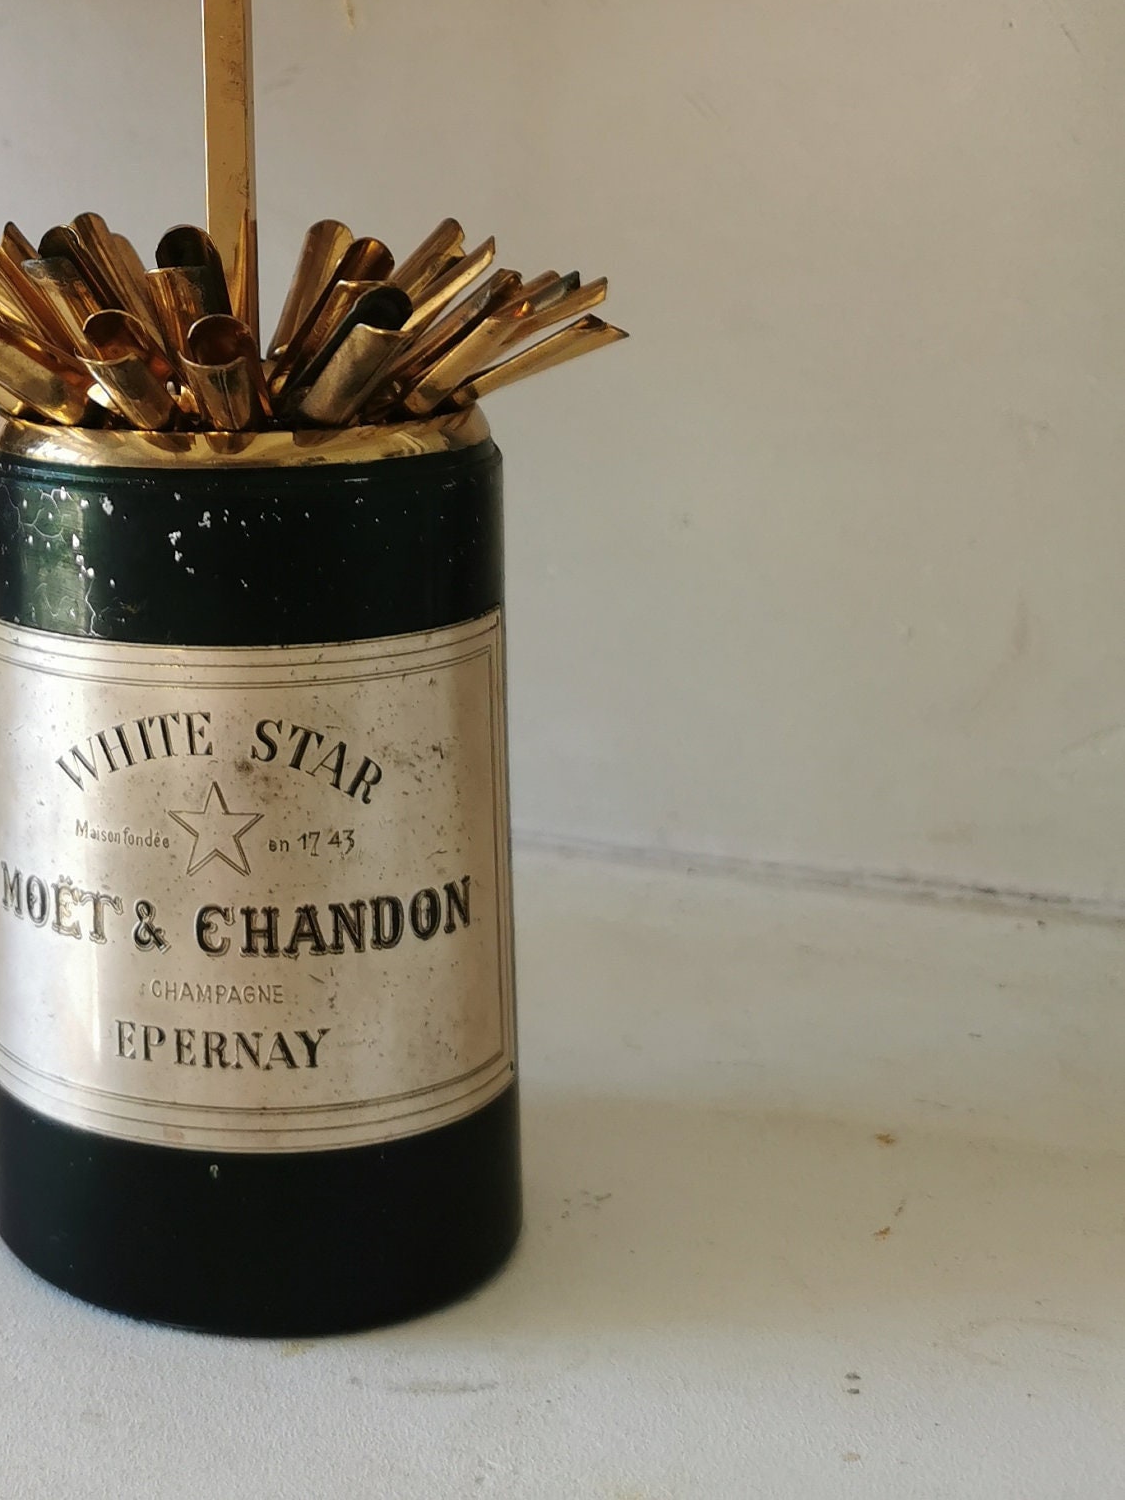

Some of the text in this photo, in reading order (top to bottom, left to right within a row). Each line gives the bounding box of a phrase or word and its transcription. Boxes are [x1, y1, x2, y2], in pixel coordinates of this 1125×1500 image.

[55, 711, 383, 805] WHITE STAR
[75, 818, 121, 845] Maison
[269, 838, 289, 852] en
[297, 829, 355, 857] 1743
[1, 860, 472, 959] MOËT & CHANDON
[150, 979, 284, 1005] CHAMPAGNE
[115, 1019, 331, 1071] EPERNAY
